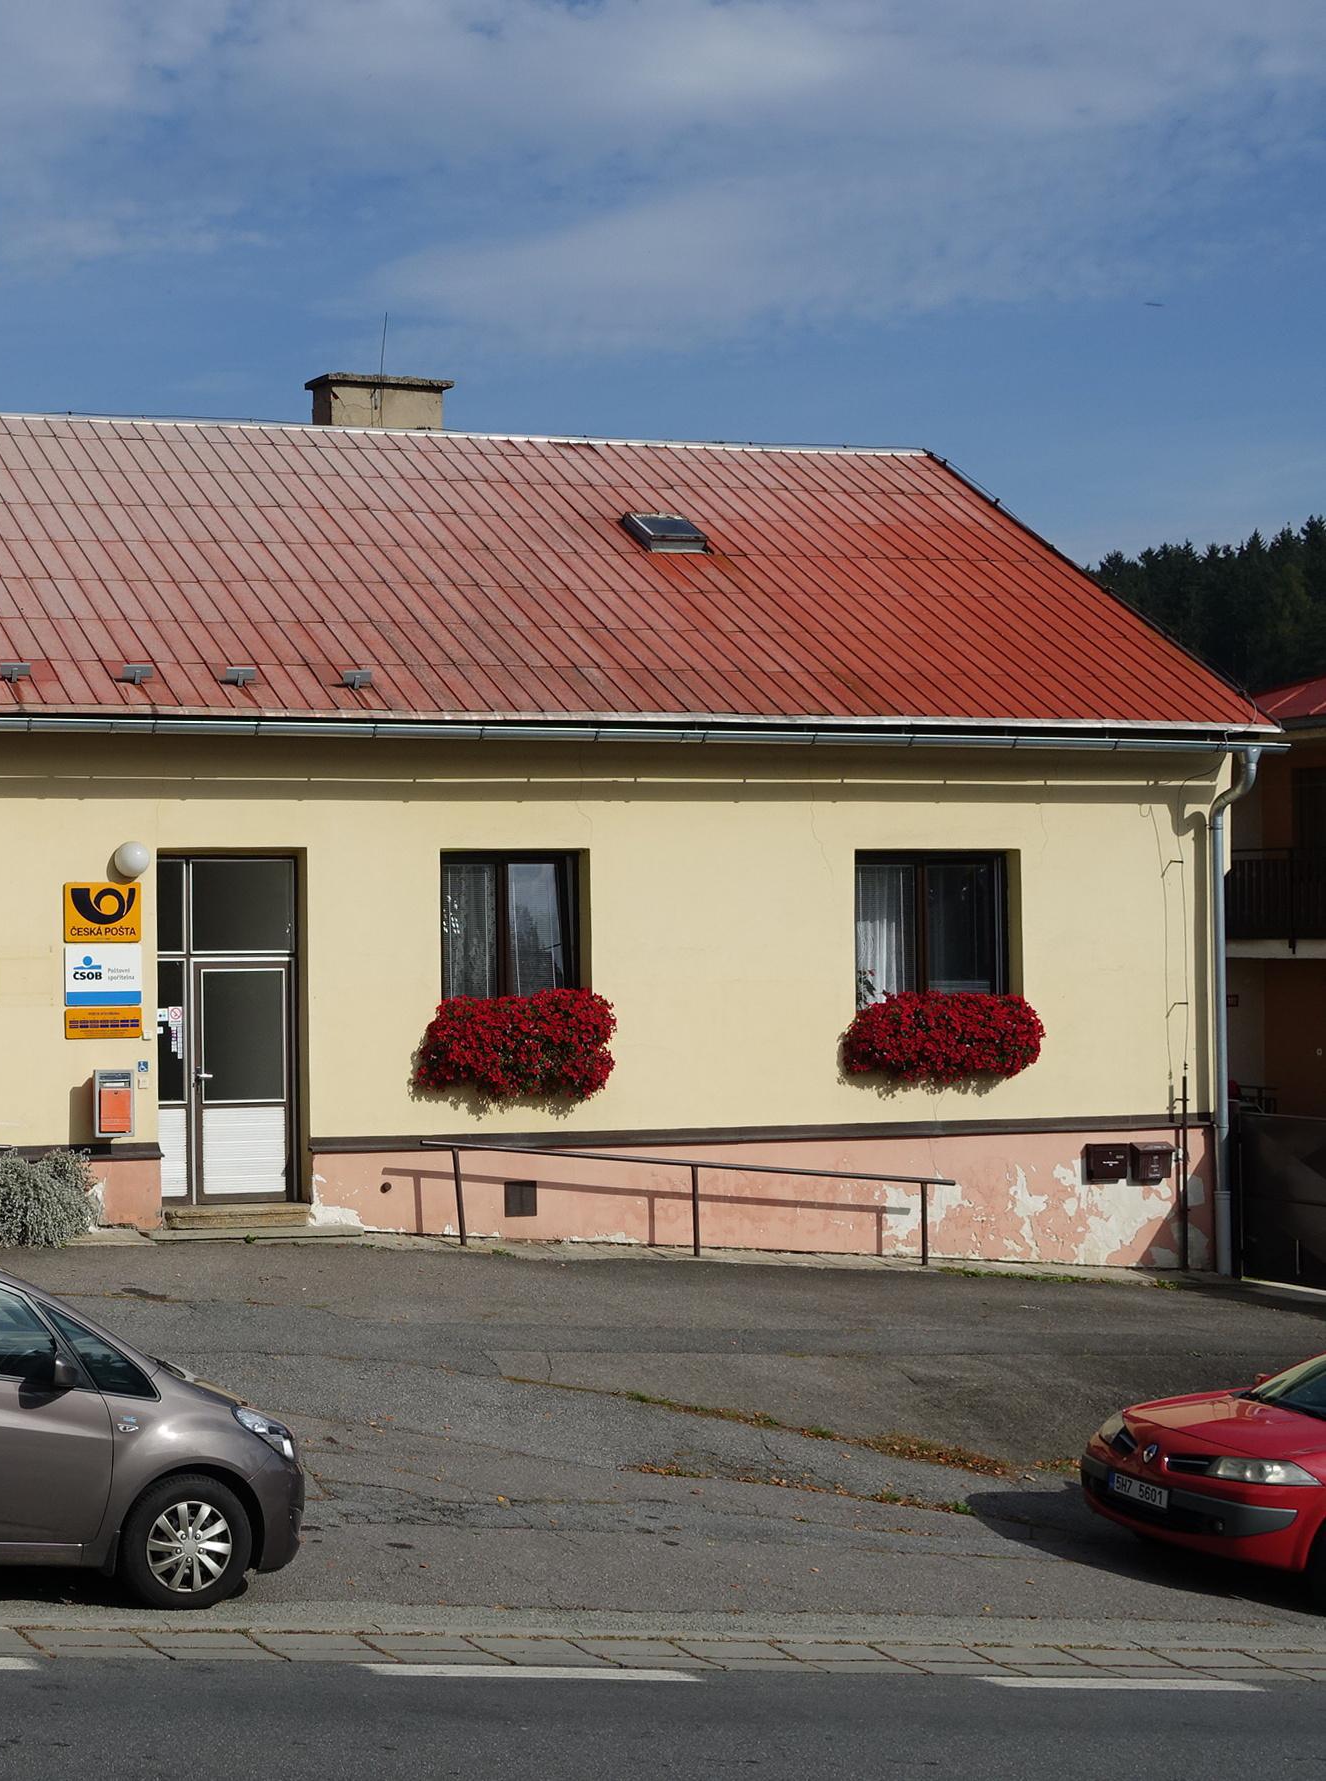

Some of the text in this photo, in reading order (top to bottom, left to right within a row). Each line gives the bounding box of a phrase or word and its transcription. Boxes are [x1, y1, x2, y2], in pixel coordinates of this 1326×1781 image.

[70, 925, 136, 936] ČESKÁ POŠTA
[73, 971, 102, 980] ČSOB
[1116, 1475, 1162, 1505] 5H7 5601
